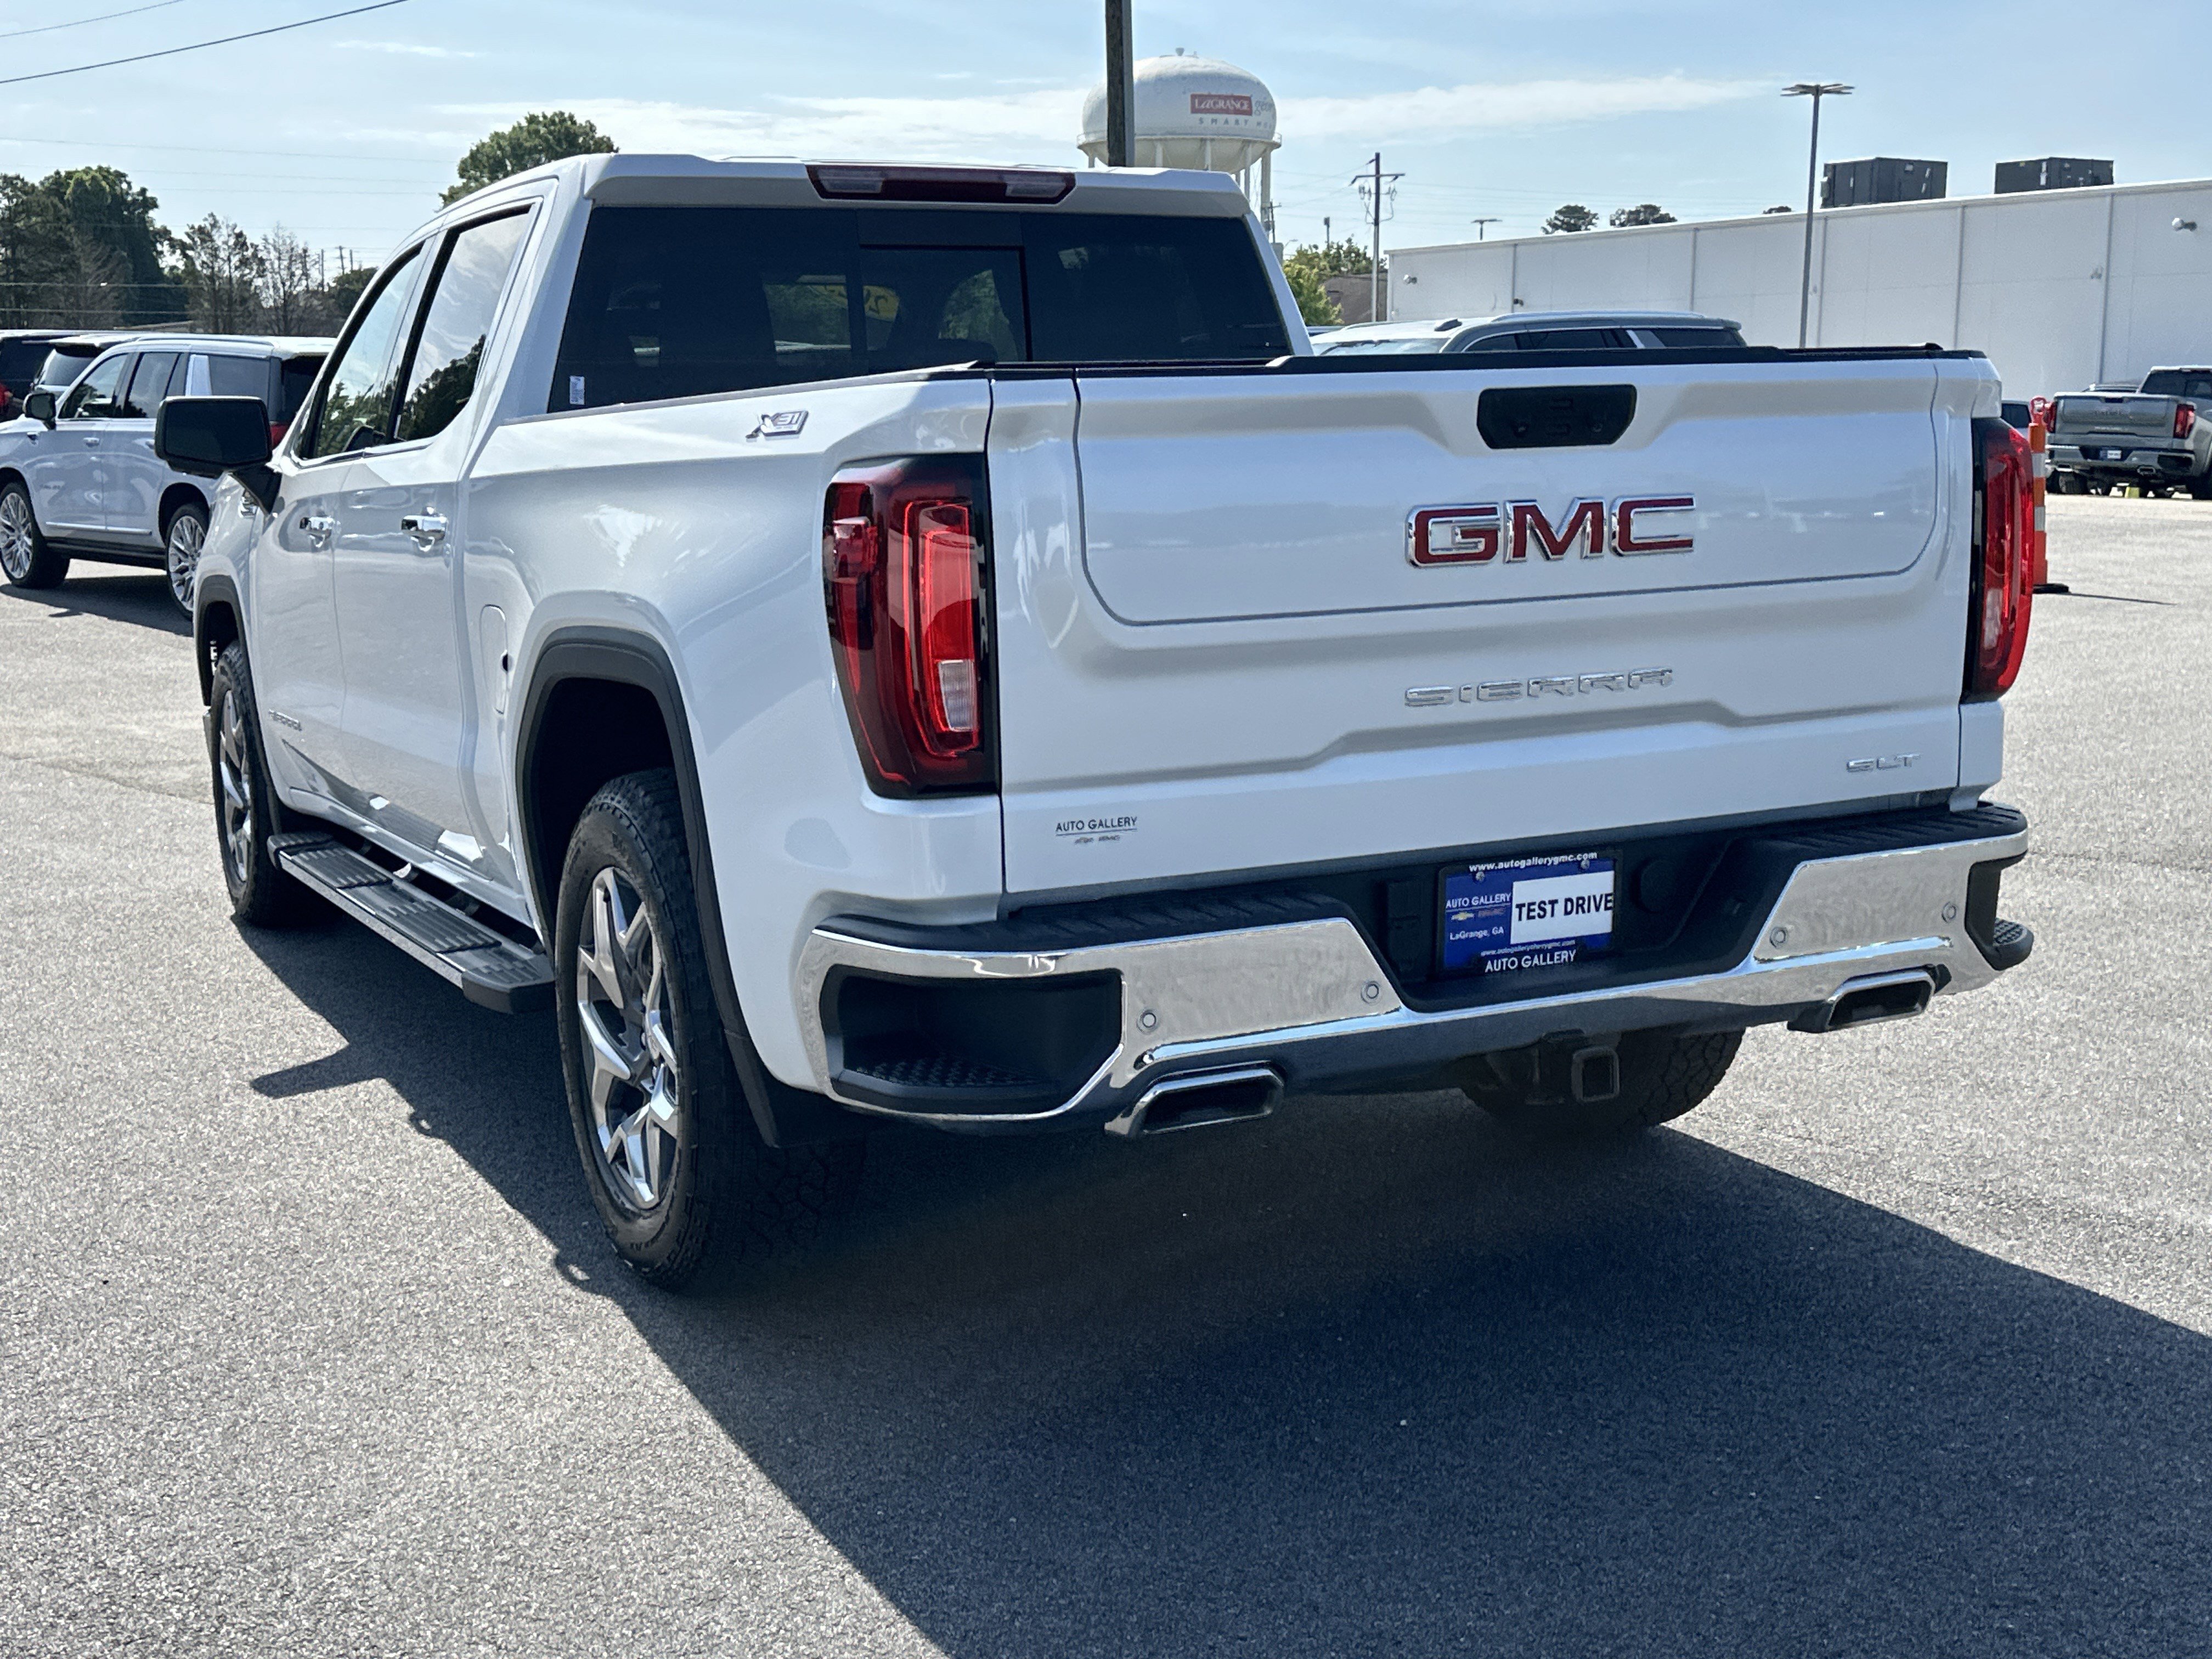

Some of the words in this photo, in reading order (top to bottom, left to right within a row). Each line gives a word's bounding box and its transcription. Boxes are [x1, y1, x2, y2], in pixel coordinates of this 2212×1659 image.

[1404, 493, 1696, 569] GMC
[1404, 667, 1673, 707] SIERRA
[1846, 753, 1921, 772] SLT
[1055, 820, 1085, 832] AUTO
[1087, 816, 1138, 830] GALLERY
[1469, 851, 1598, 872] www.autogallerygmc.com
[1446, 897, 1470, 909] AUTO
[1471, 892, 1511, 906] GALLERY
[1515, 899, 1559, 922] TEST
[1564, 892, 1613, 916] DRIVE
[1492, 926, 1504, 935] GA
[1485, 957, 1519, 973] AUTO
[1521, 949, 1576, 968] GALLERY
